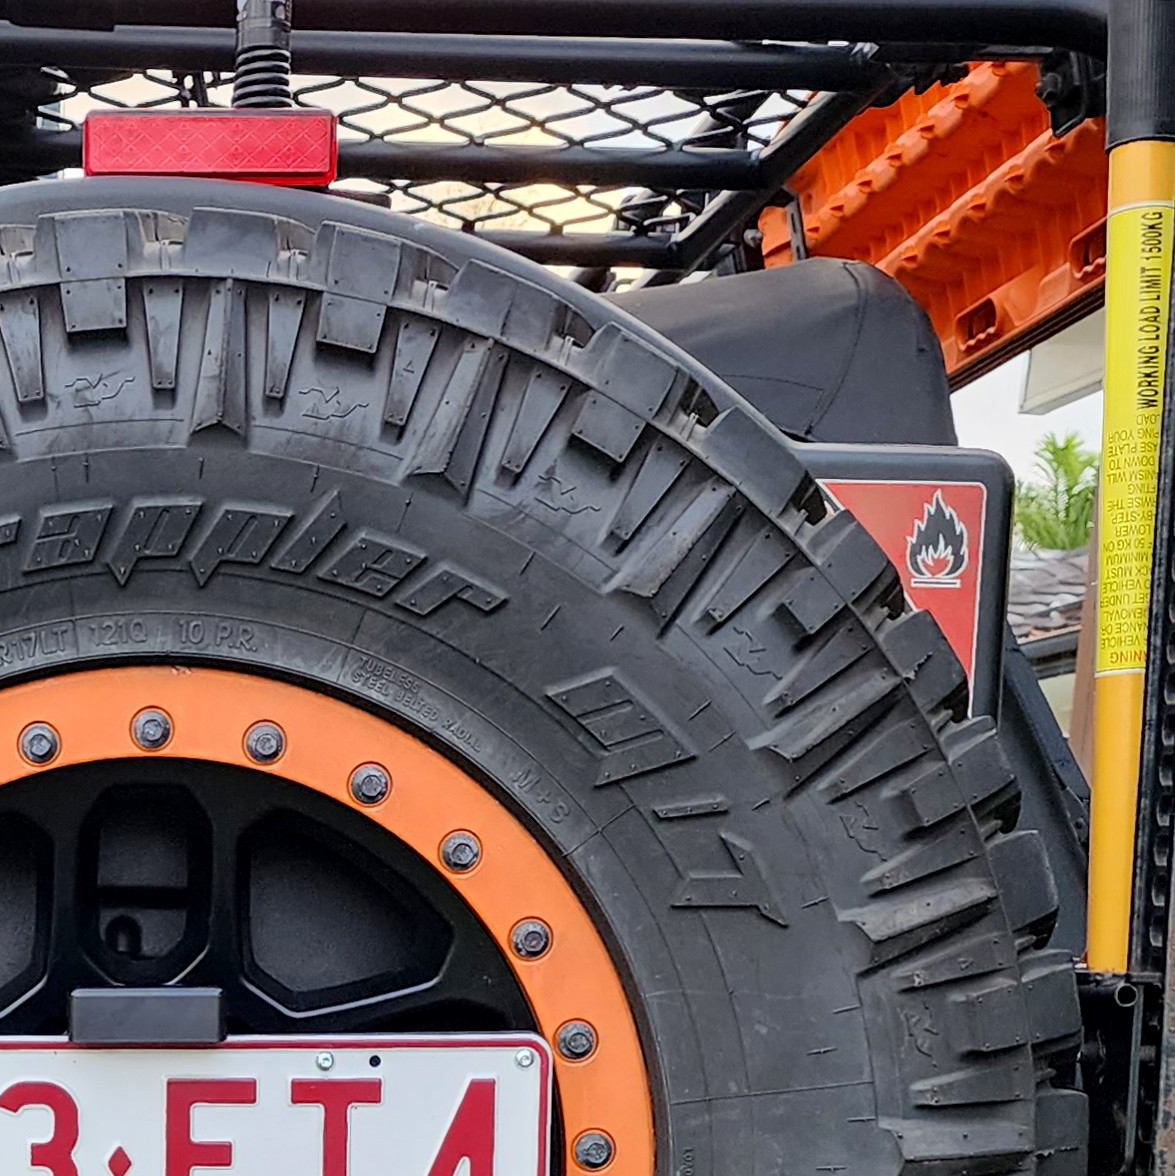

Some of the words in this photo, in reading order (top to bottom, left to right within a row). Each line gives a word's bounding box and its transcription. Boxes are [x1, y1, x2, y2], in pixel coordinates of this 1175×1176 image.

[1139, 266, 1162, 302] LIMIT
[1138, 306, 1161, 342] LOAD
[1137, 345, 1160, 411] WORKING
[1108, 443, 1137, 457] PLATE
[1109, 459, 1121, 470] TO
[1124, 456, 1155, 469] DOWN
[1106, 472, 1127, 484] WILL
[1107, 499, 1125, 512] THE
[1115, 524, 1151, 537] LOWER
[1117, 539, 1131, 551] KG
[1134, 537, 1145, 549] 50
[1106, 552, 1148, 565] MINIMUM
[1106, 566, 1132, 579] MUST
[1103, 579, 1142, 594] VEHICLE
[1100, 594, 1130, 608] UNDER
[89, 619, 148, 647] 121Q
[177, 619, 205, 646] 10
[215, 622, 259, 653] P.R.
[1100, 635, 1140, 649] VEHICLE
[358, 657, 422, 694] TUBELESS
[352, 671, 391, 697] STEEL
